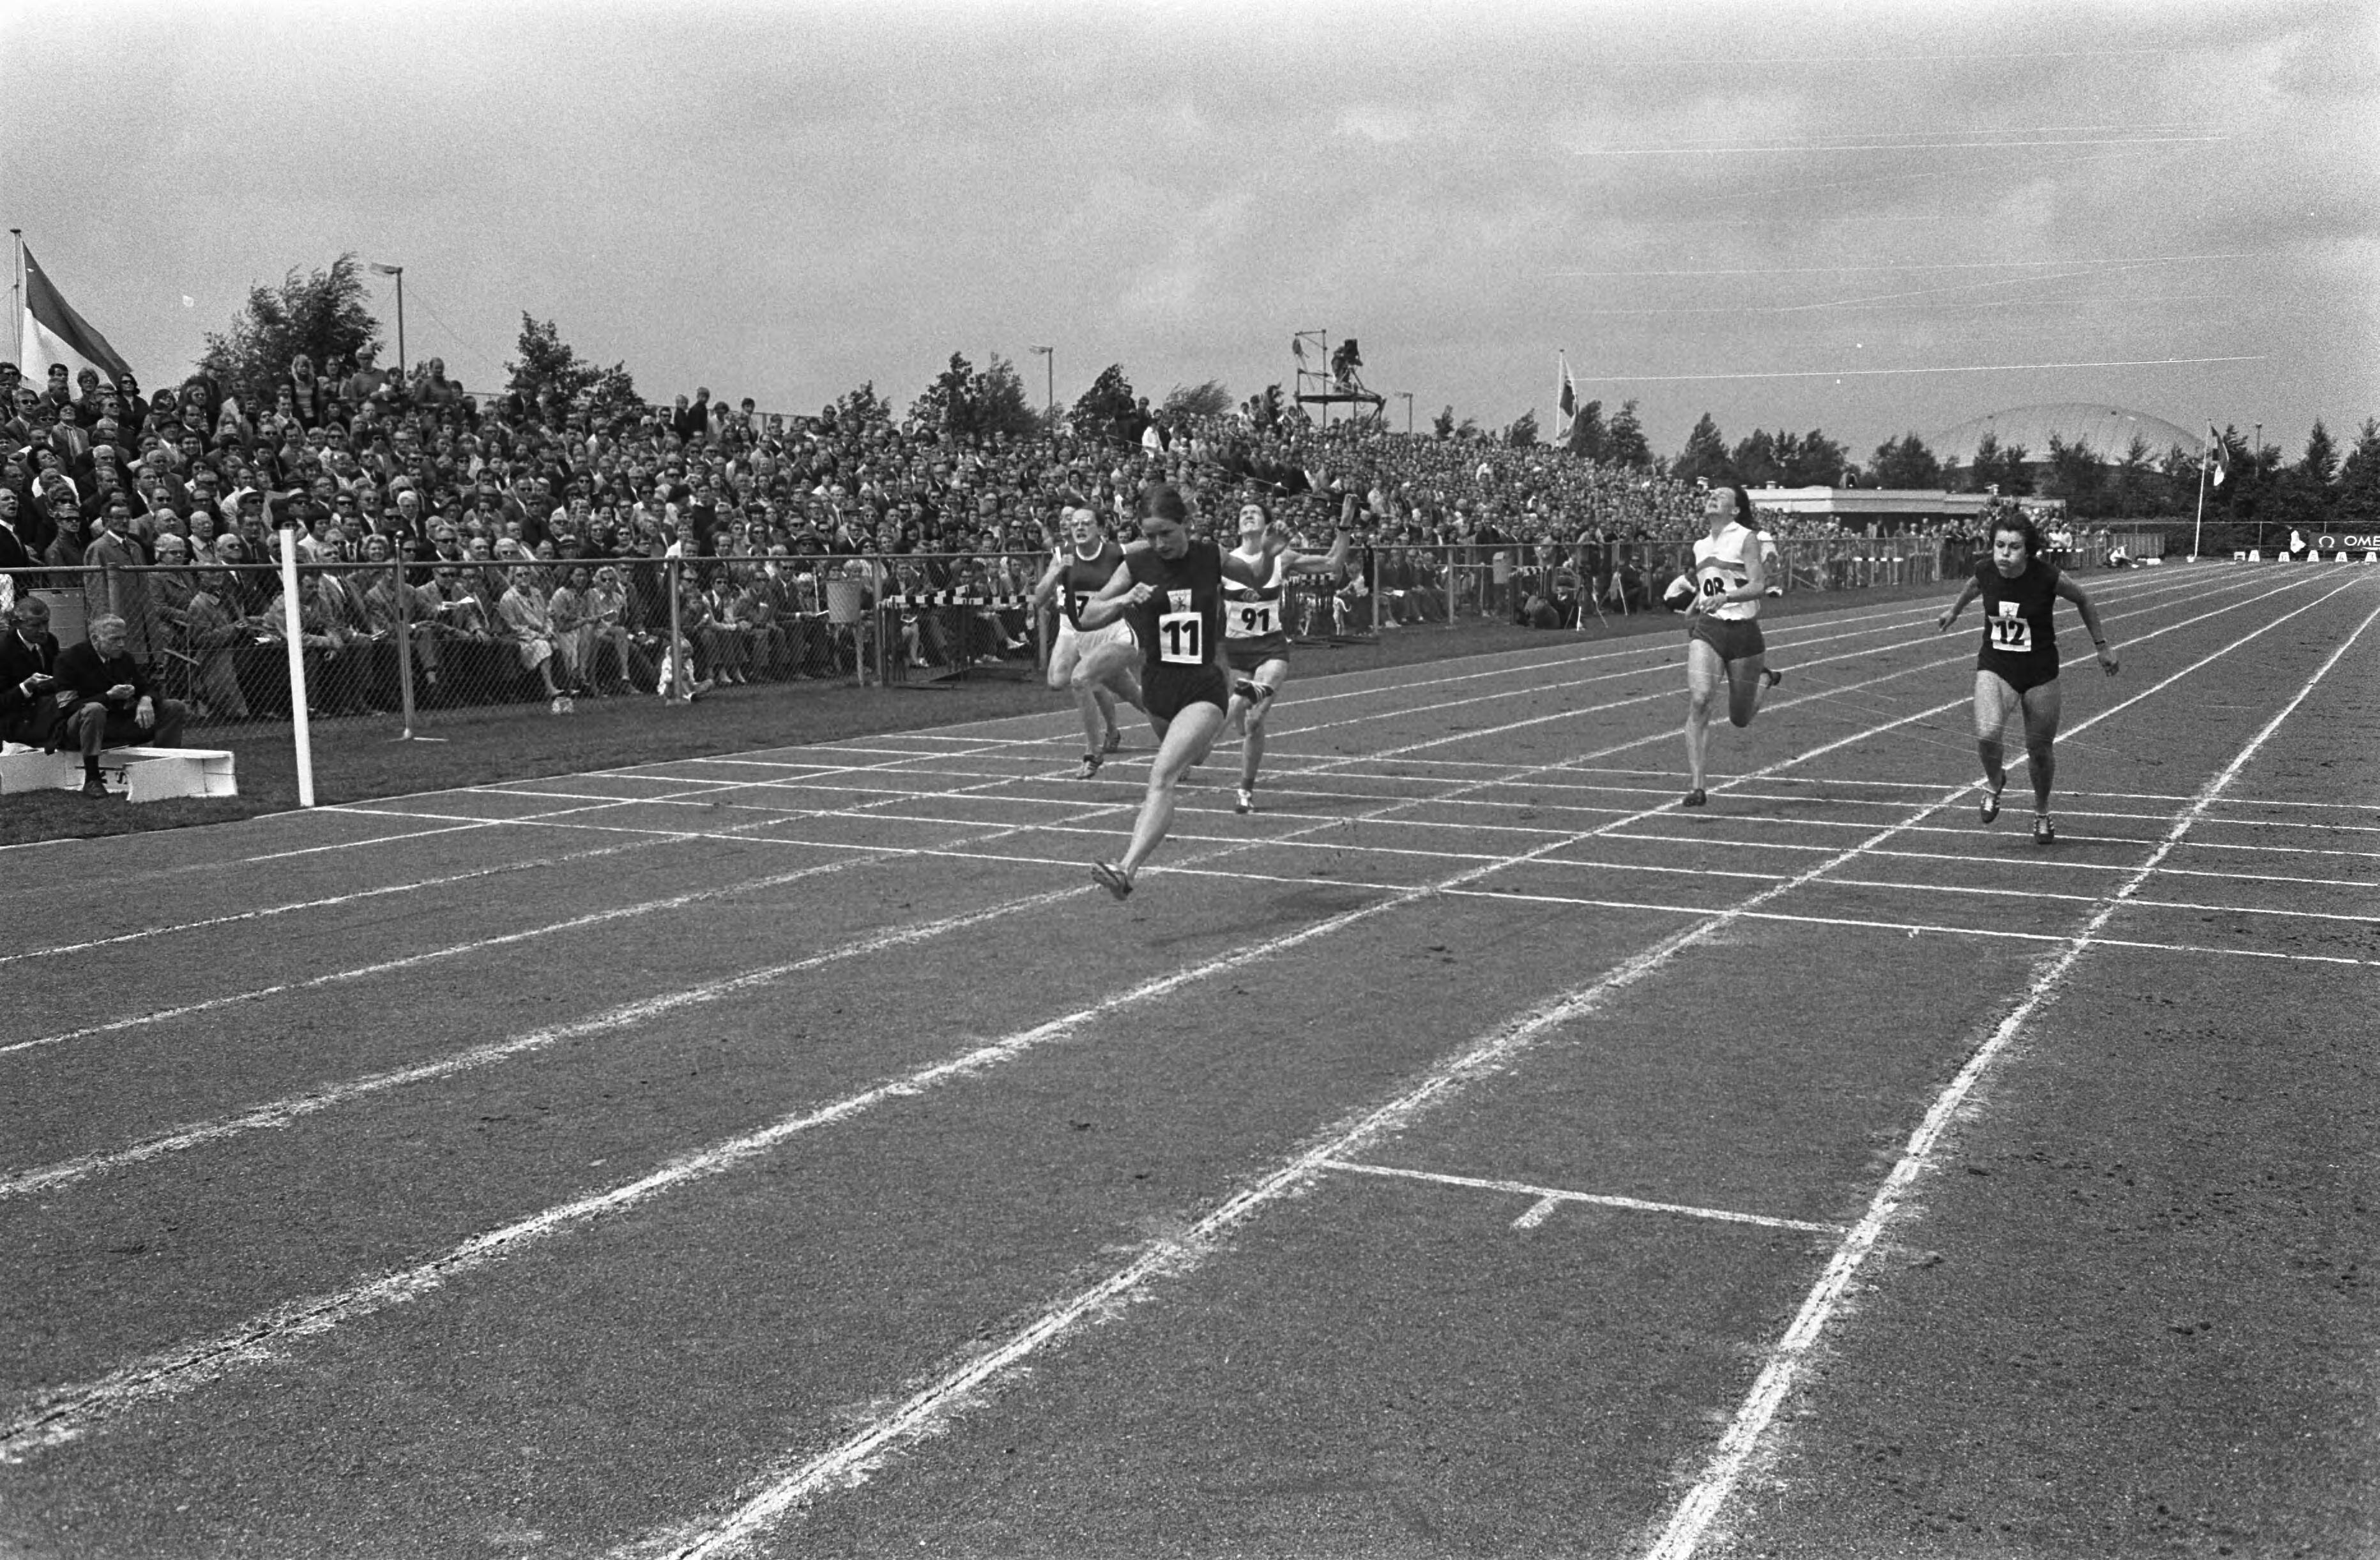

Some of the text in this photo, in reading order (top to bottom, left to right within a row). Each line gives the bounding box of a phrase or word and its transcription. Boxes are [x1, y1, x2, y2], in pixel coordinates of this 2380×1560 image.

[1242, 608, 1269, 631] 91
[1163, 620, 1198, 656] 11
[1994, 621, 2025, 646] 12
